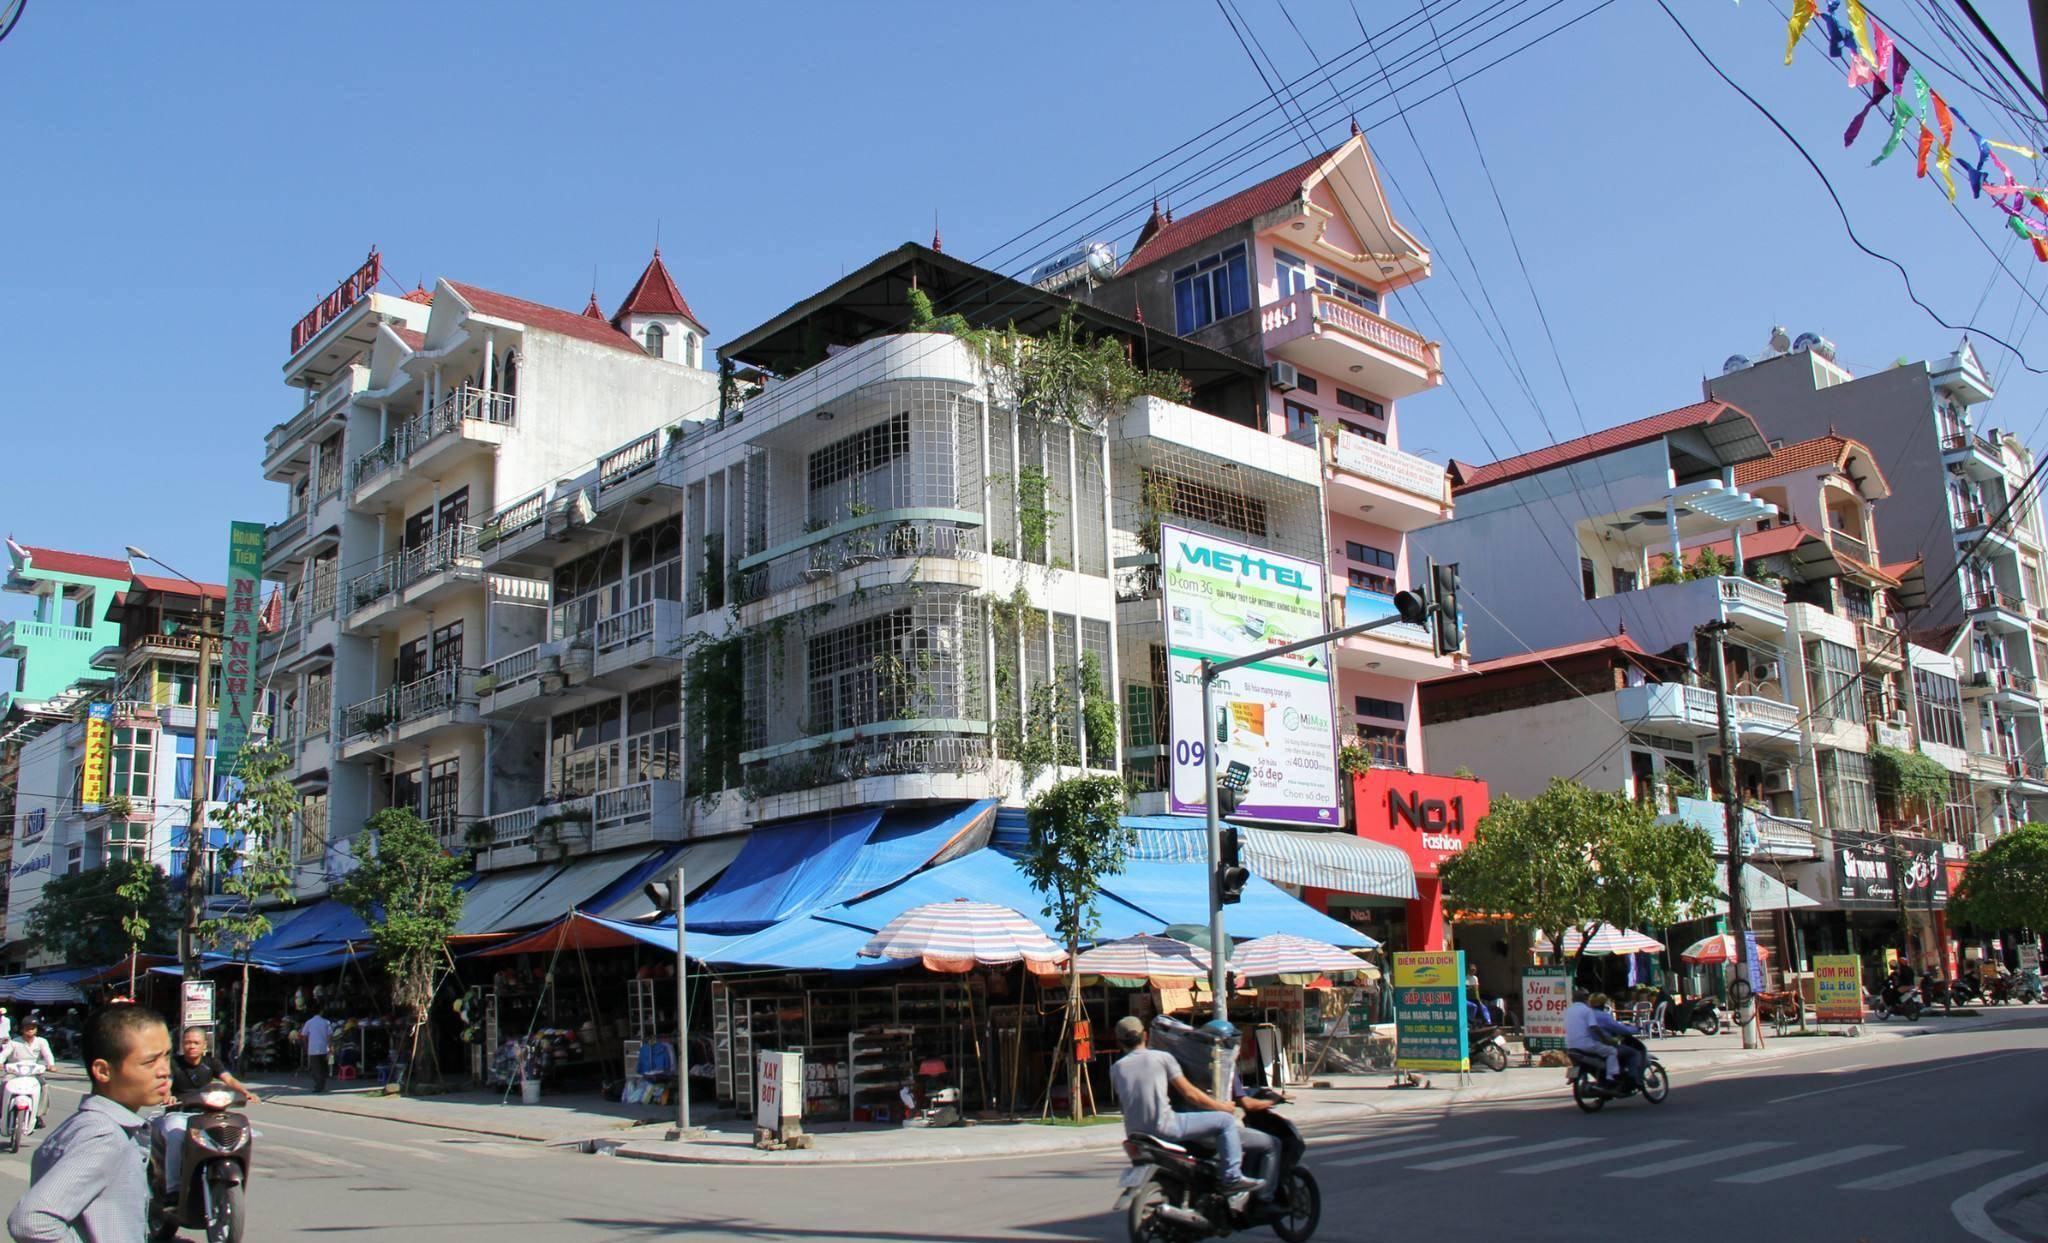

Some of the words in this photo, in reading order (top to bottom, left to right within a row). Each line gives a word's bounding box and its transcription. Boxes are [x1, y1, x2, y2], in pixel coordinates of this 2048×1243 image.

[1179, 541, 1312, 591] VIETTEL
[1202, 583, 1213, 595] 3G
[1293, 758, 1319, 770] 40.000
[1253, 767, 1264, 778] Số
[1388, 788, 1464, 834] No.1
[1422, 833, 1462, 850] Fashion
[1527, 981, 1550, 995] Sim
[763, 1061, 778, 1080] XAY
